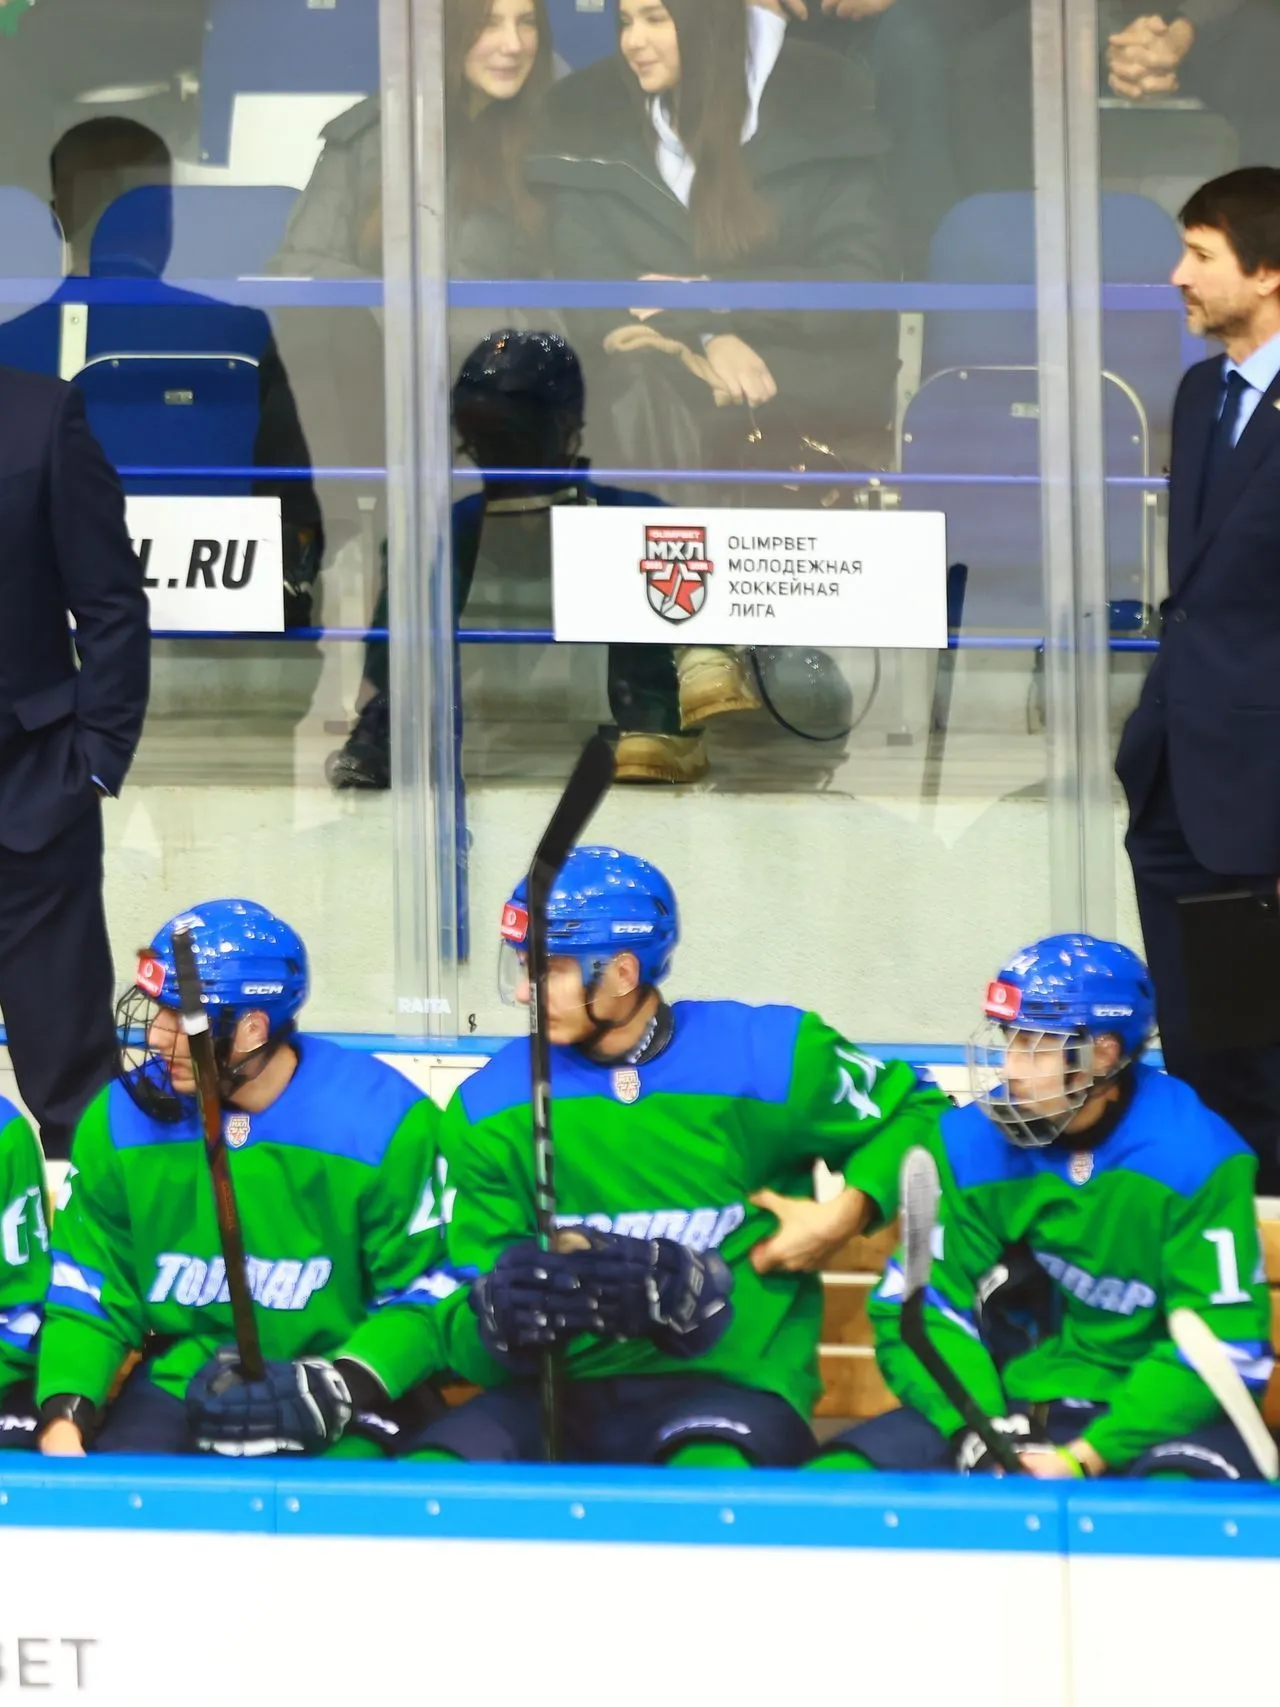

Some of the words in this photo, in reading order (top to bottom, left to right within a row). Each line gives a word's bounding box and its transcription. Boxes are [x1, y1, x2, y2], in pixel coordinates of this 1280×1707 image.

[647, 540, 705, 560] МХЛ
[728, 535, 818, 551] OLIMPBET
[131, 539, 258, 589] L.RU
[728, 558, 863, 576] МОЛОДЕЖНАЯ
[728, 577, 840, 596] ХОККЕЙНАЯ
[729, 602, 776, 617] ЛИГА
[244, 984, 283, 996] CCM
[397, 996, 452, 1015] RAITA
